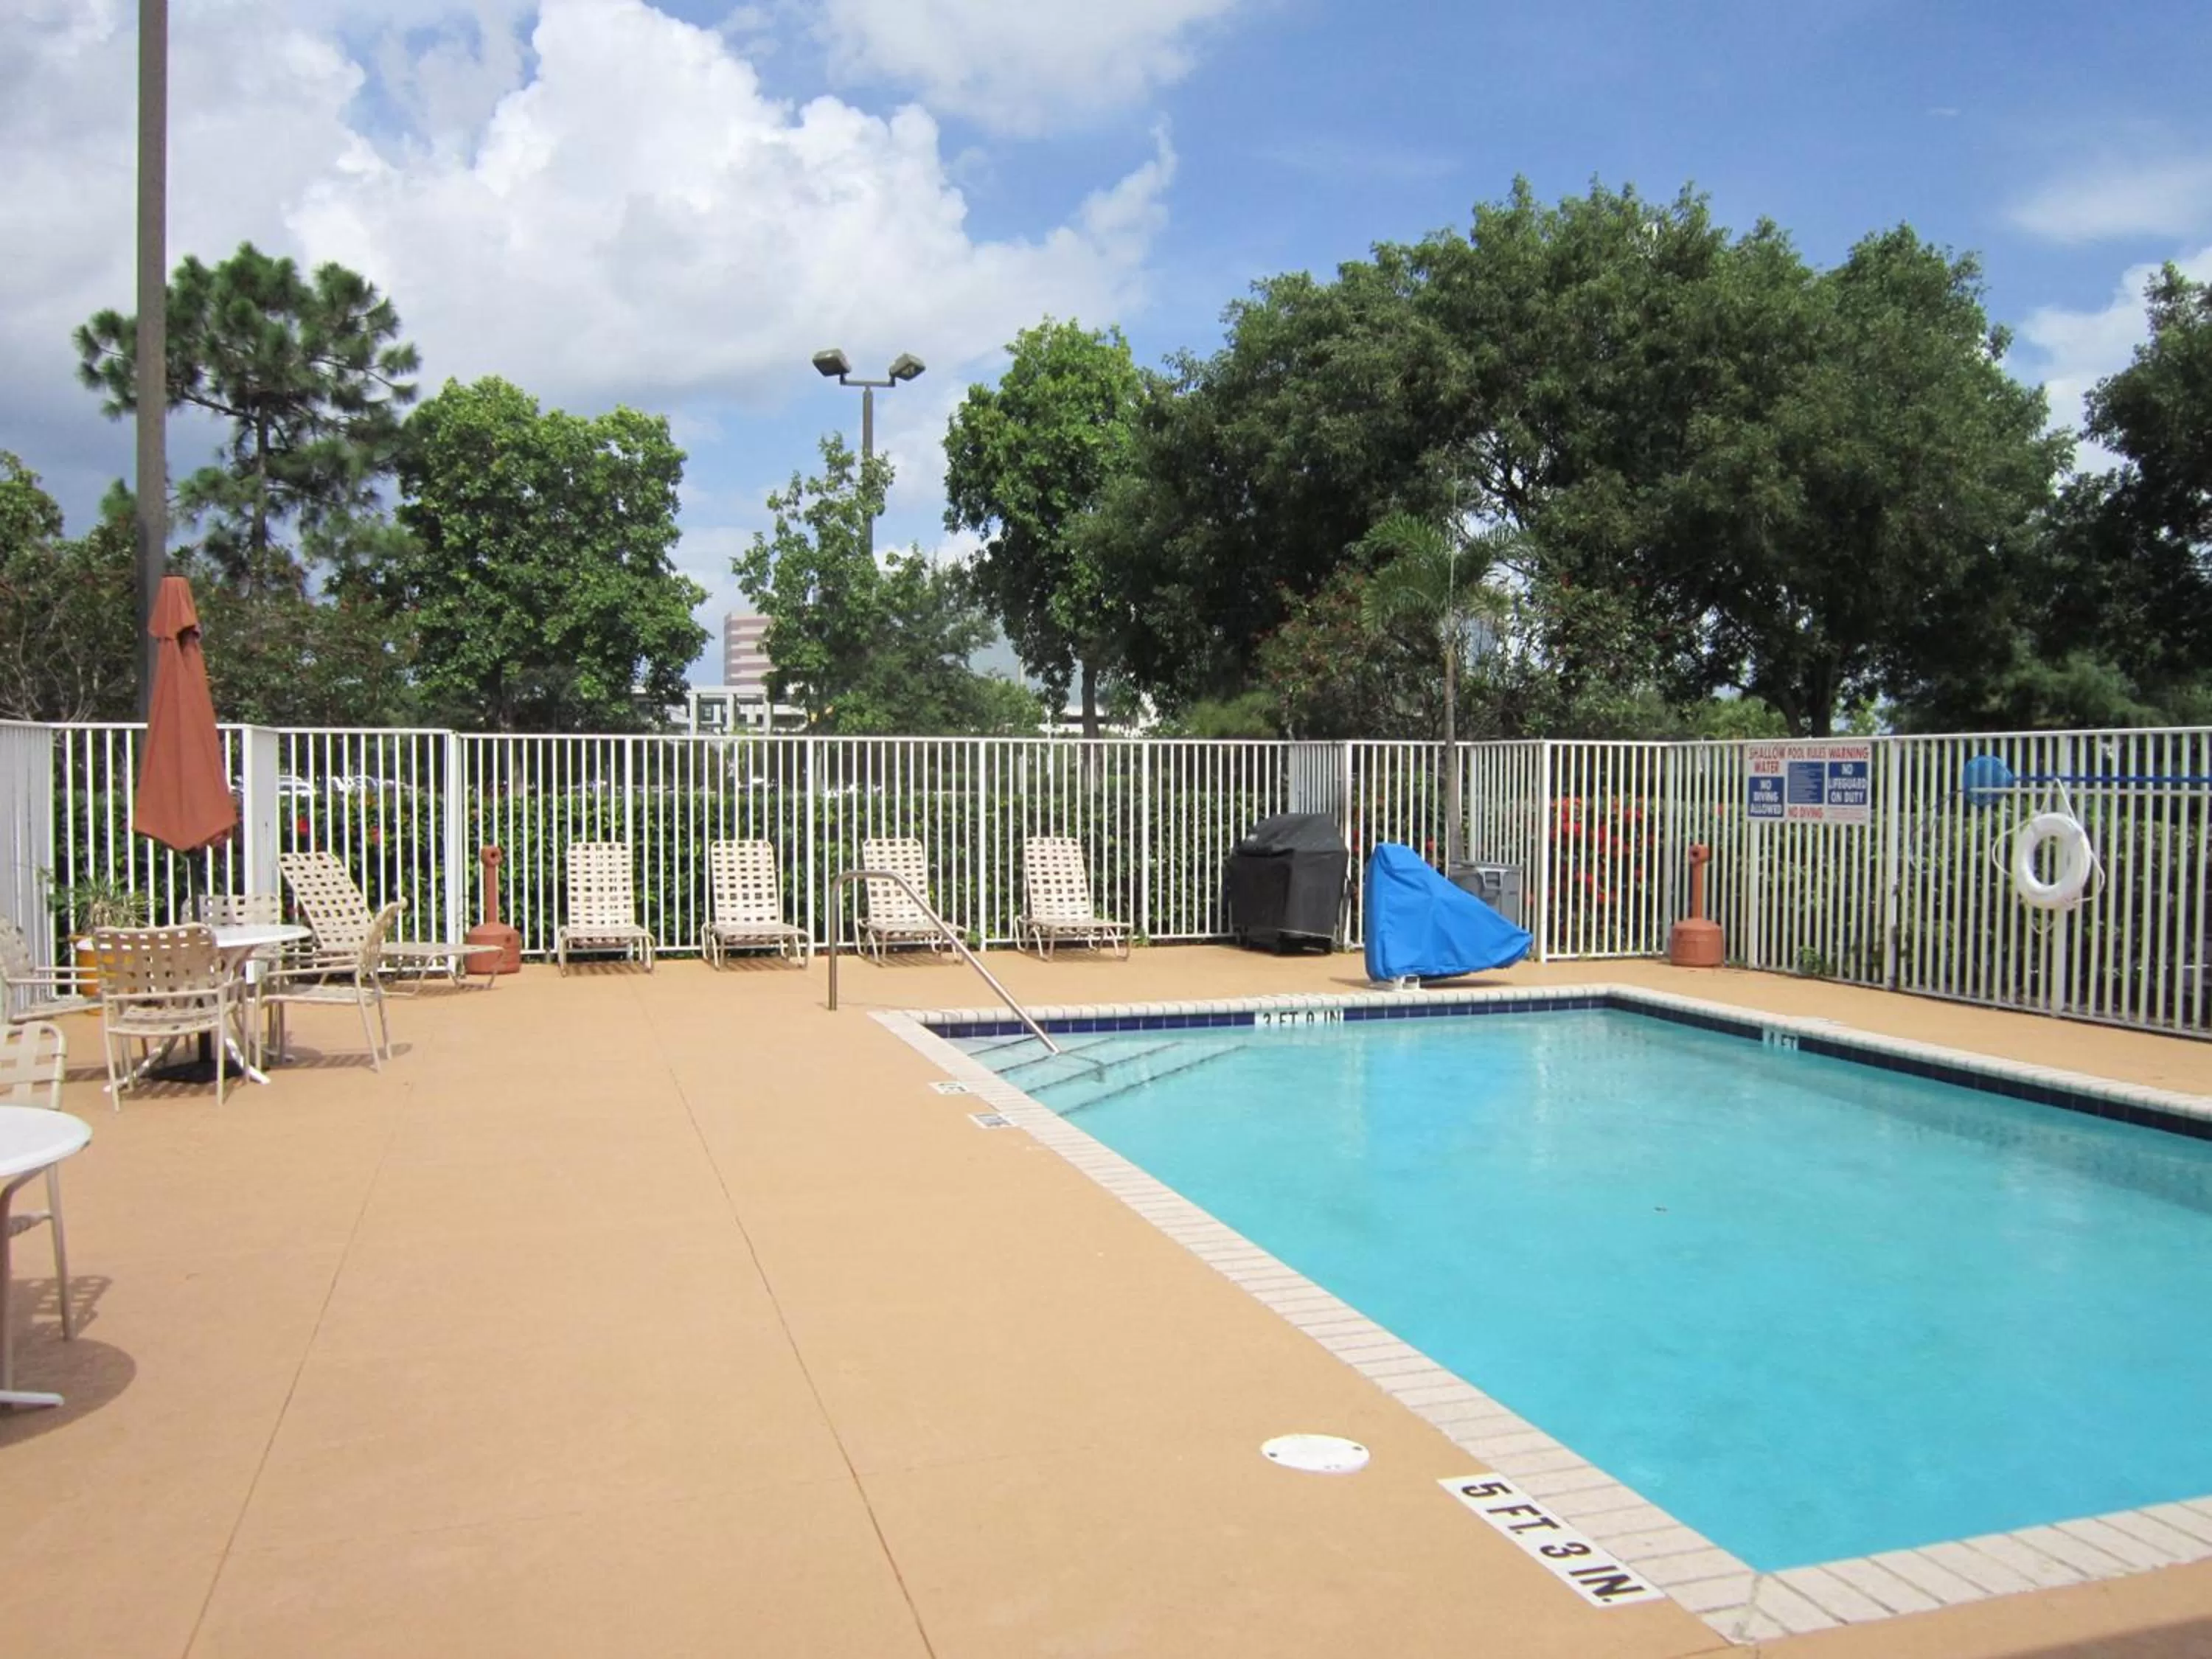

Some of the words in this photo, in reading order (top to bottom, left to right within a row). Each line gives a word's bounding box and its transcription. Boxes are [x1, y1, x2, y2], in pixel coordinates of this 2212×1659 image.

[1748, 746, 1786, 759] SHALLOW
[1788, 746, 1805, 759] POOL
[1828, 745, 1869, 759] WARNING
[1754, 760, 1779, 773] WATER
[1841, 763, 1854, 775] NO
[1760, 779, 1773, 790] NO
[1828, 778, 1868, 789] LIFEGUARD
[1753, 791, 1779, 802] DIVING
[1830, 791, 1843, 803] ON
[1843, 791, 1865, 803] DUTY
[1750, 803, 1782, 815] ALLOWED
[1788, 807, 1798, 818] NO
[1799, 807, 1824, 818] DIVING
[1279, 1011, 1298, 1024] FT
[1324, 1009, 1340, 1023] IN
[1461, 1481, 1513, 1498] 5
[1486, 1504, 1560, 1534] FT.
[1540, 1542, 1591, 1559] 3
[1568, 1565, 1645, 1603] IN.
